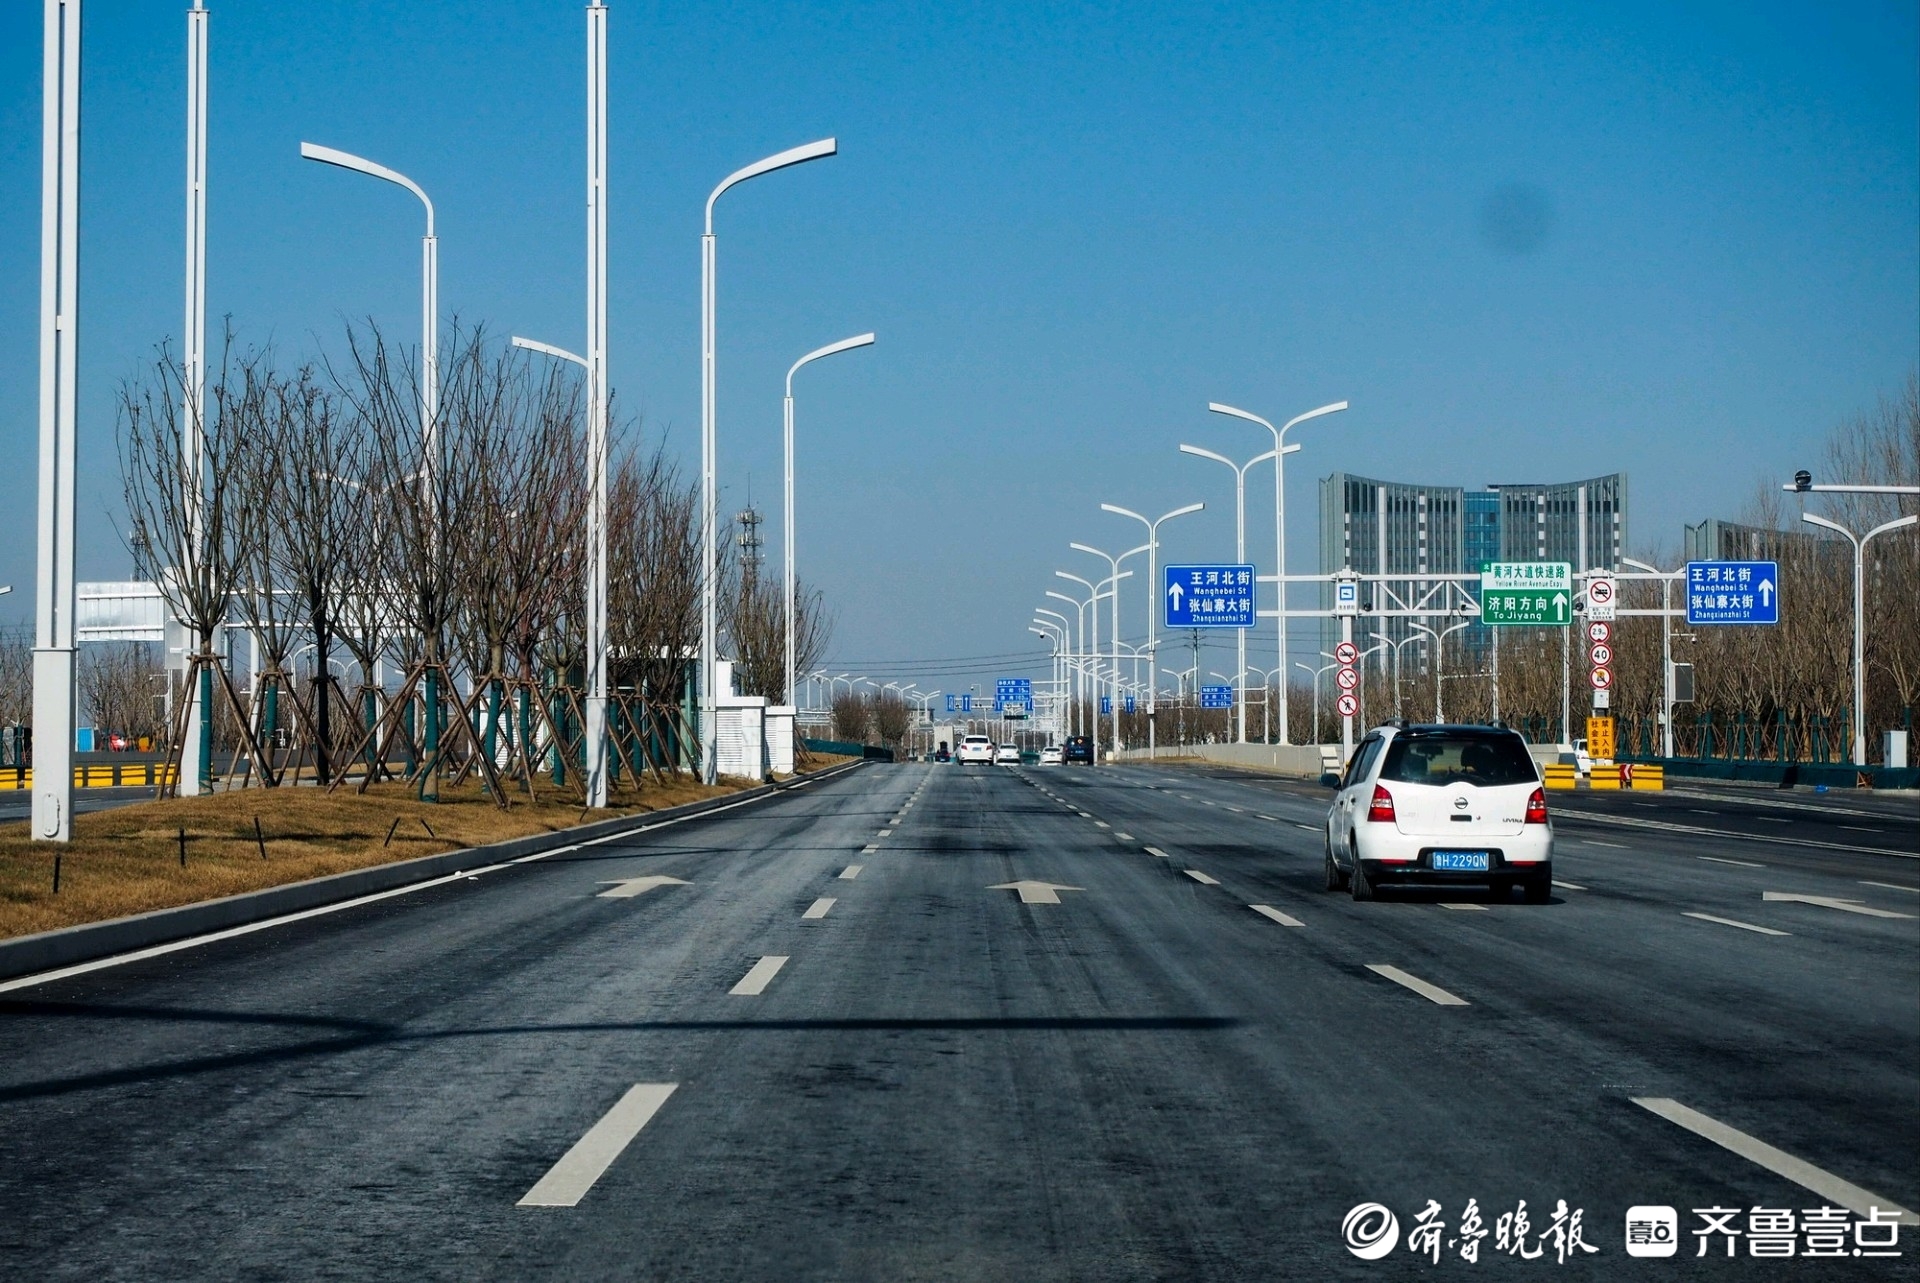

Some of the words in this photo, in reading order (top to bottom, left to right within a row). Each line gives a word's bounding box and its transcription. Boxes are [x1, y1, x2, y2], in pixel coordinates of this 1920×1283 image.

[1190, 571, 1250, 586] 王河北街
[1493, 565, 1565, 579] 黄河大道快速路
[1691, 567, 1752, 582] 王河北街
[1513, 580, 1528, 588] River
[1529, 580, 1549, 588] Avenue
[1694, 583, 1737, 593] Wanghebei
[1738, 583, 1748, 591] St
[1194, 587, 1236, 597] Wanghebei
[1238, 587, 1247, 595] St
[1189, 598, 1251, 613] 张仙寨大街
[1488, 596, 1548, 611] 济阳方向
[1691, 594, 1754, 609] 张仙寨大街
[1239, 614, 1247, 622] St
[1493, 611, 1505, 619] To
[1507, 611, 1542, 621] Jiyang
[1743, 610, 1750, 618] St
[1594, 650, 1607, 660] 40
[1591, 720, 1599, 756] 社会车辆
[1601, 720, 1610, 756] 禁止入内
